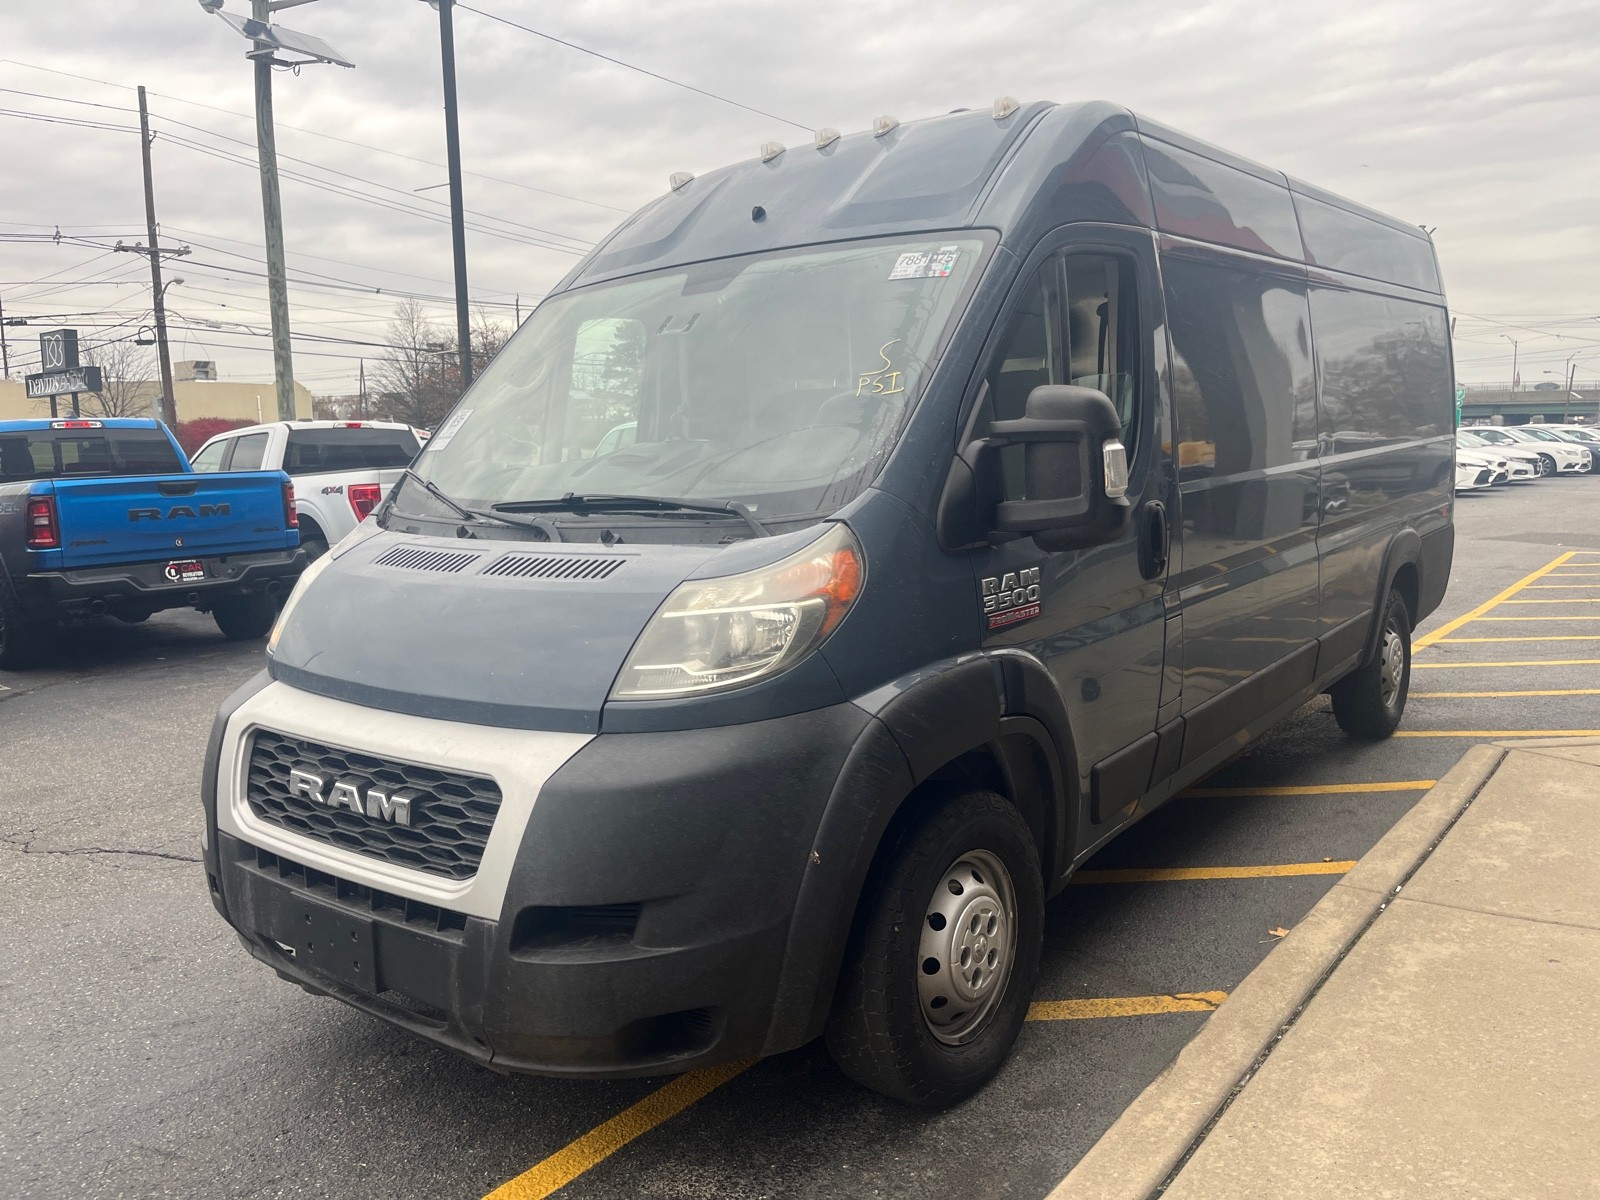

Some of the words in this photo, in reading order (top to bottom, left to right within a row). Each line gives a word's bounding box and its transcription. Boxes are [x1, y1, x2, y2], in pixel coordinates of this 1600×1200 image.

[856, 371, 905, 397] PSI
[128, 503, 231, 521] RAM
[181, 563, 203, 572] CAR
[981, 566, 1040, 595] RAM
[983, 584, 1041, 613] 3500
[289, 769, 411, 826] RAM
